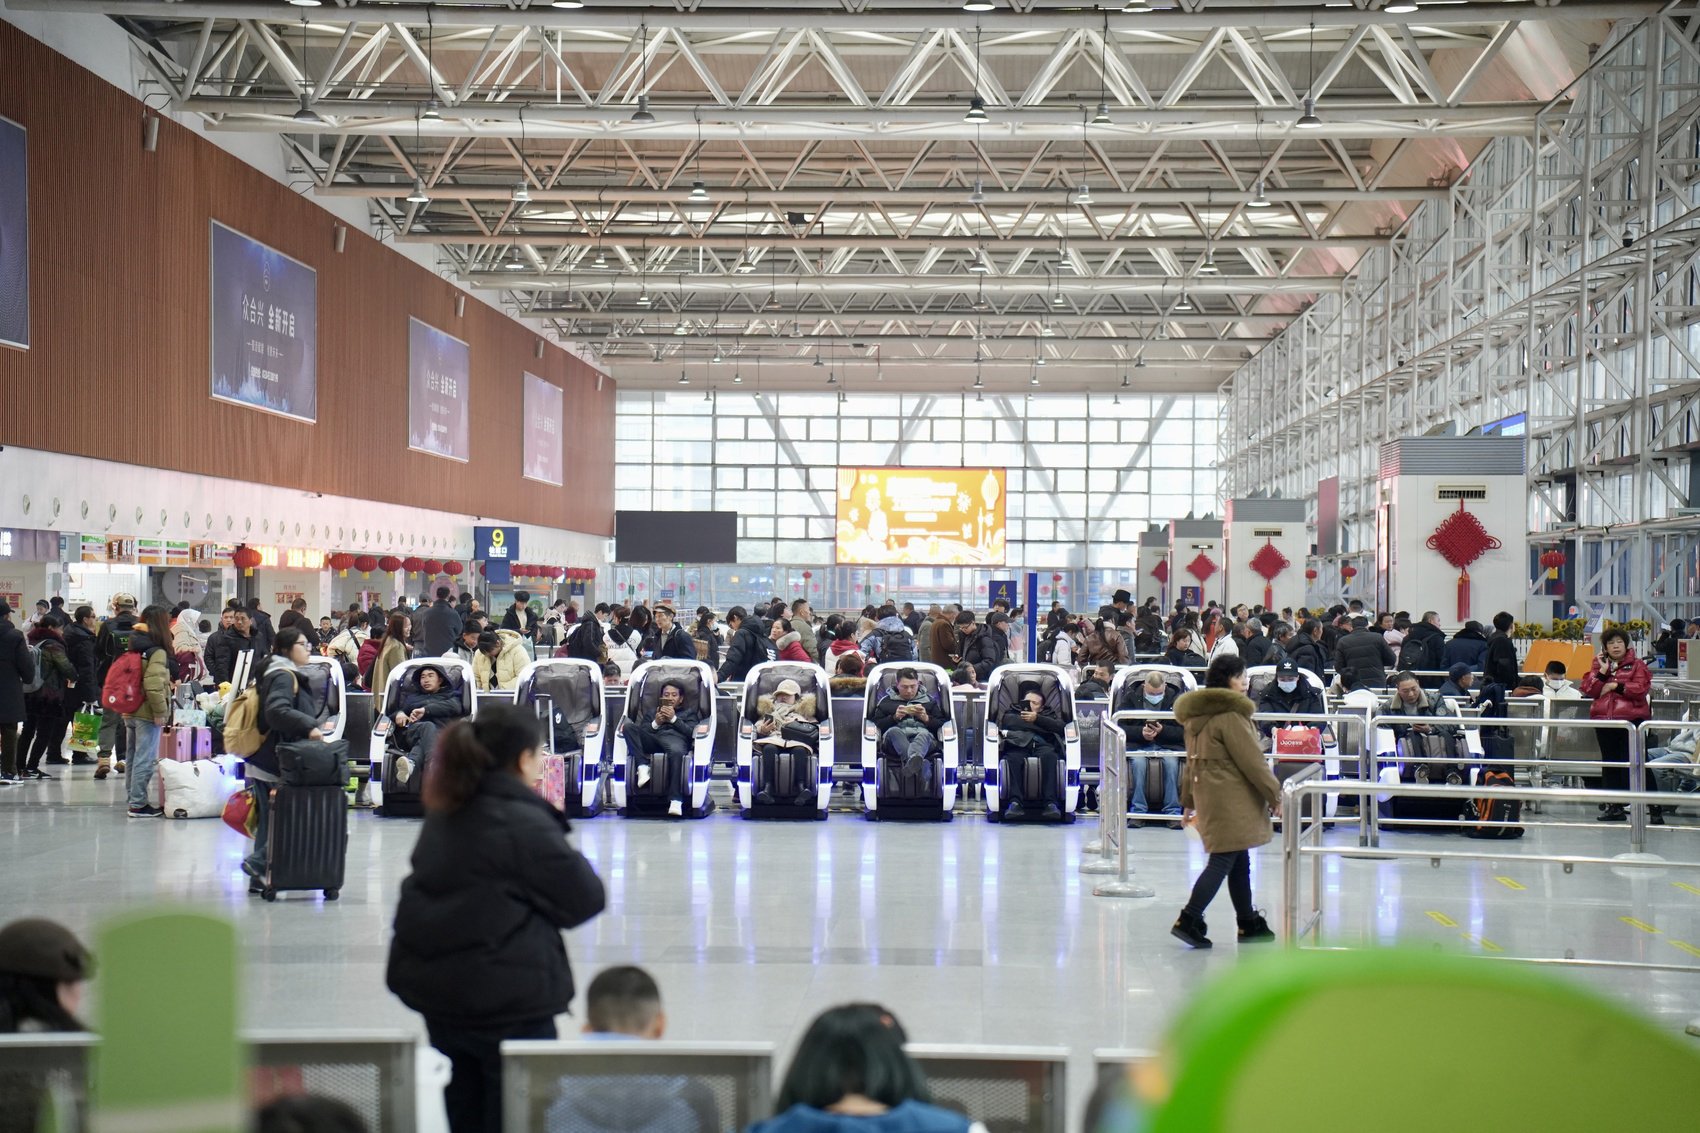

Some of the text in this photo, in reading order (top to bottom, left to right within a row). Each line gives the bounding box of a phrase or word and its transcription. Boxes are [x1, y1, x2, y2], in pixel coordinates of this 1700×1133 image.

[242, 293, 295, 339] 众合兴 全新开启
[492, 528, 504, 547] 9
[998, 584, 1007, 597] 4
[1186, 588, 1193, 599] 5
